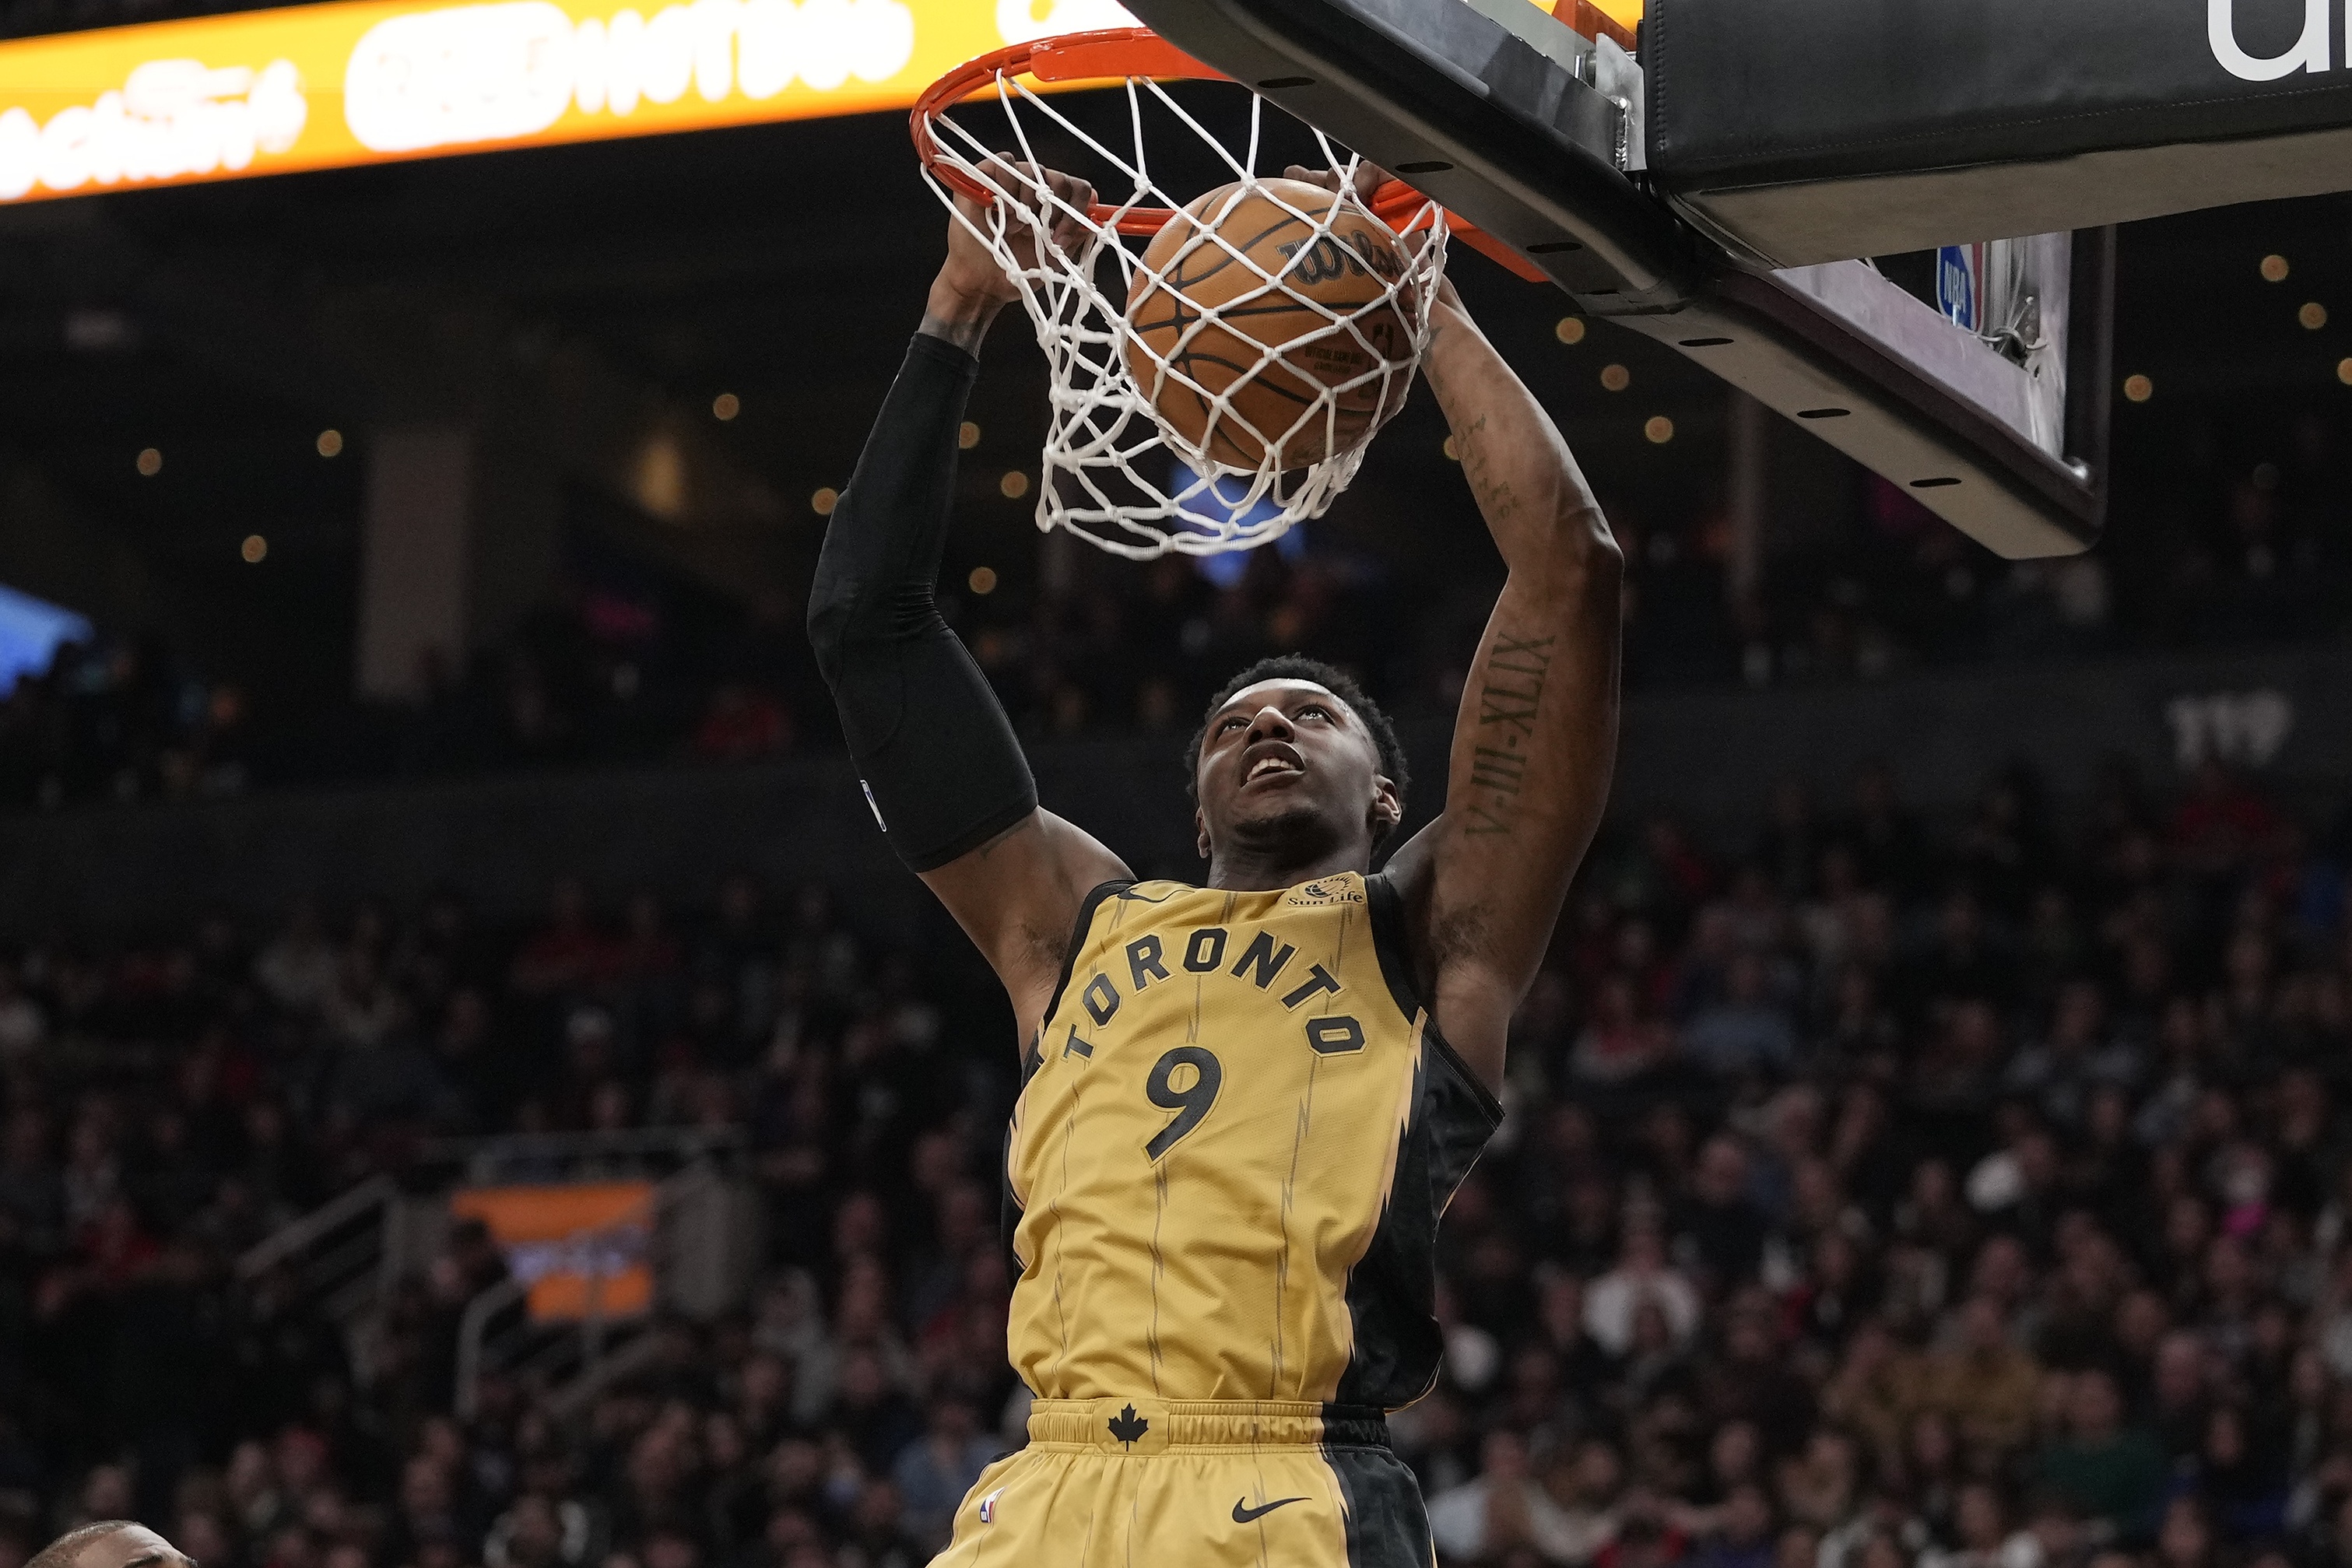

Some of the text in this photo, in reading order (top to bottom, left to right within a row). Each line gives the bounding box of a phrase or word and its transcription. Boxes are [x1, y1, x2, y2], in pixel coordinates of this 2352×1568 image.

[1944, 260, 1966, 314] NBA
[1287, 890, 1364, 906] Sun Life
[1062, 926, 1367, 1059] TORONTO
[1144, 1045, 1223, 1163] 9
